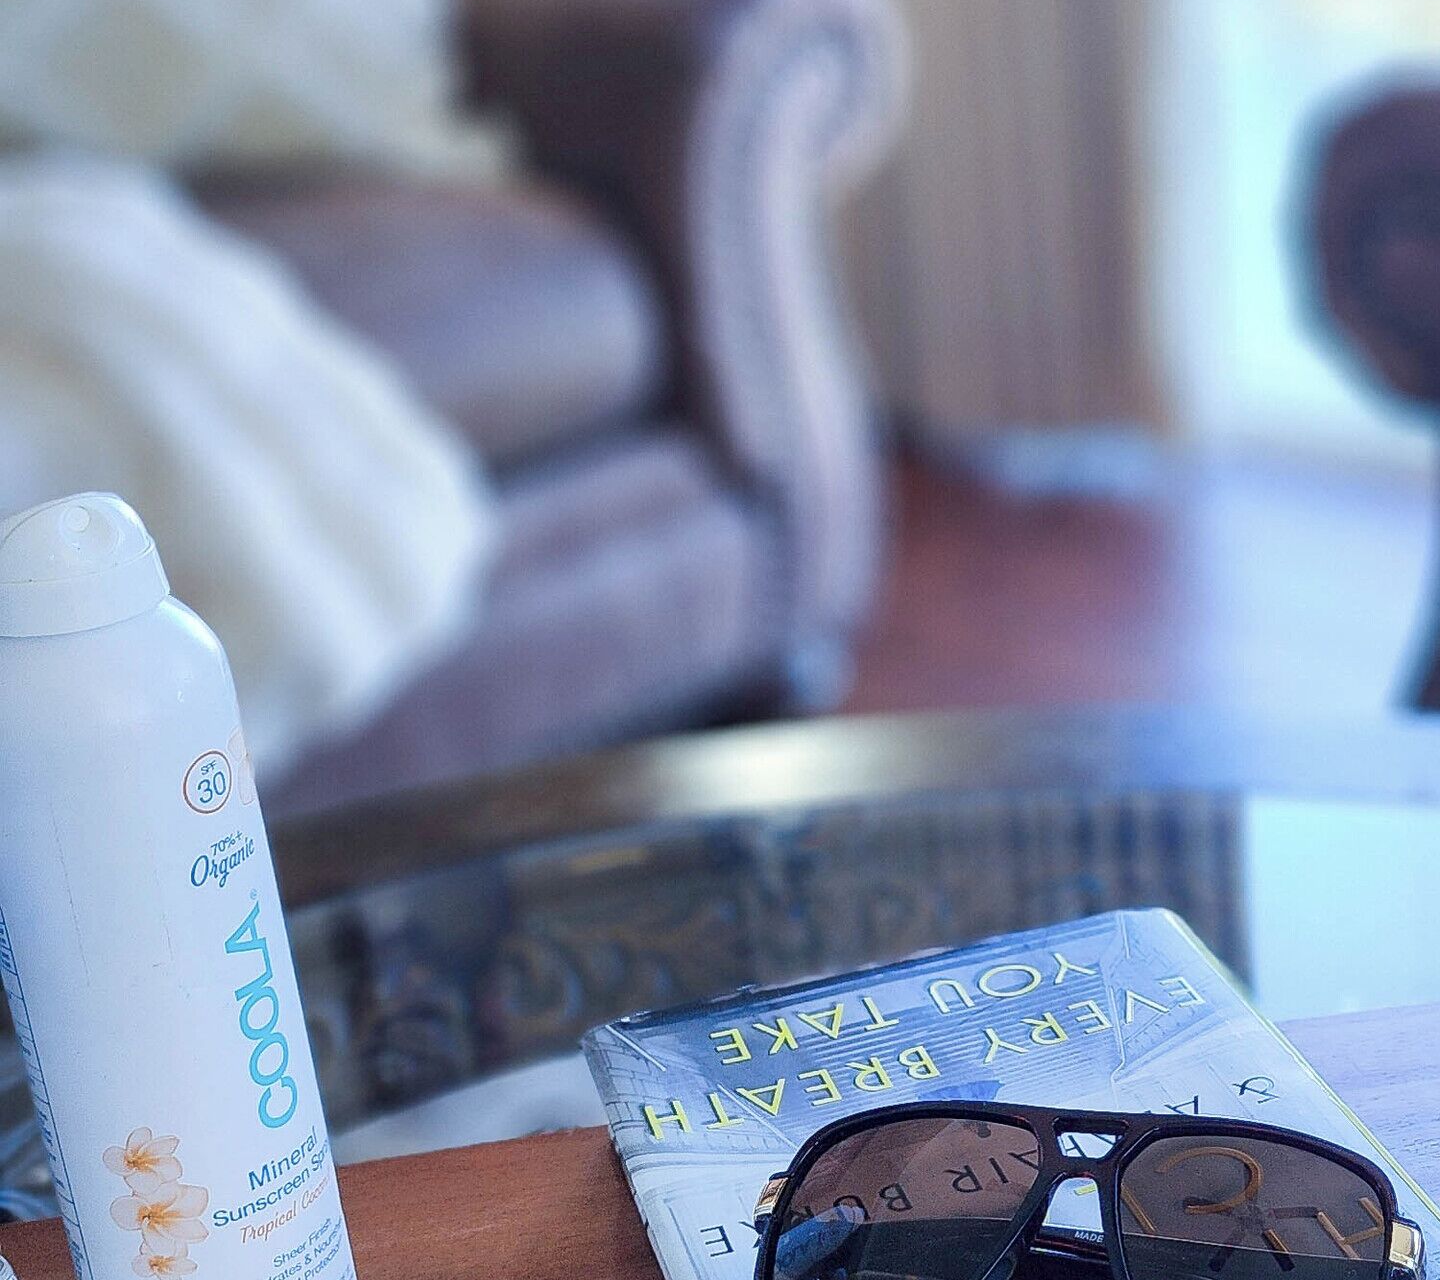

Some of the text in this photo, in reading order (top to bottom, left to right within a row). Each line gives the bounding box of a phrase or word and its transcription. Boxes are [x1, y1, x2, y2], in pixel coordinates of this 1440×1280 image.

[197, 771, 226, 804] 30
[200, 760, 217, 776] SPF
[190, 837, 255, 888] Organic
[224, 899, 298, 1129] COOLA
[709, 952, 1099, 1065] YOU TAKE
[645, 975, 1208, 1141] EVERY BREATH
[248, 1125, 318, 1191] Mineral
[213, 1167, 311, 1227] Sunscreen
[240, 1200, 297, 1243] Tropical
[273, 1240, 307, 1268] Sheer
[1074, 1230, 1105, 1243] MADE
